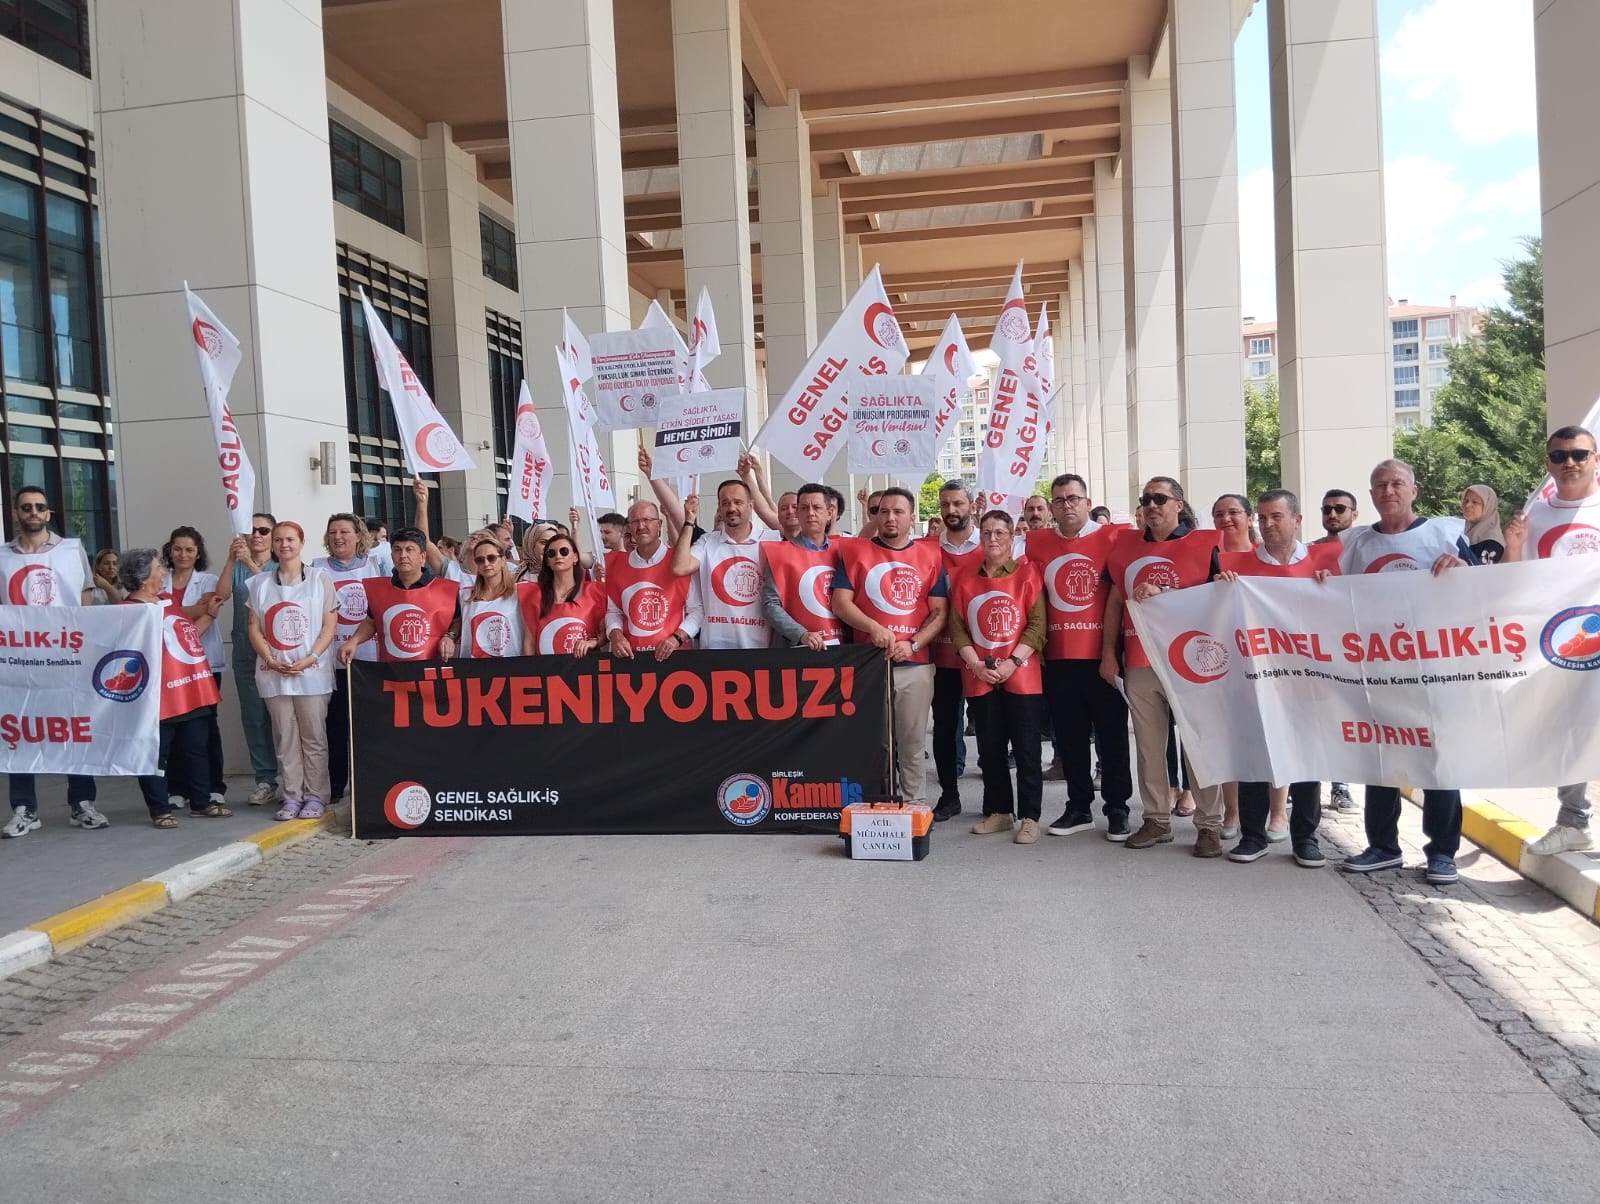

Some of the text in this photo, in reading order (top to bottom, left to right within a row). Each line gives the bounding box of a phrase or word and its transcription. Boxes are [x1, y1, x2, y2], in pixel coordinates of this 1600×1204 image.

[788, 357, 849, 426] GENEL
[860, 394, 922, 407] SAĞLIKTA
[682, 404, 717, 416] SAĞLIKTA
[853, 409, 929, 421] DÖNÜŞÜM PROGRAMINA
[661, 418, 682, 430] ETKİN
[684, 416, 710, 427] ŞİDDET
[856, 420, 927, 434] Son Verilsin!
[663, 424, 732, 444] HEMEN ŞİMDİ!
[707, 616, 729, 624] GENEL
[1234, 627, 1332, 662] GENEL
[1343, 616, 1527, 663] SAĞLIK-İŞ
[8, 657, 45, 668] Çalışanları
[46, 658, 81, 666] Sendikası
[1263, 667, 1289, 678] Sağlık
[1291, 669, 1302, 677] ve
[1367, 676, 1388, 685] Kolu
[1391, 676, 1418, 685] Kamu
[1421, 672, 1474, 685] Çalışanları
[1477, 670, 1527, 681] Sendikası
[383, 660, 855, 728] TÜKENİYORUZ!
[0, 713, 92, 750] ŞUBE
[1341, 719, 1432, 748] EDİRNE
[772, 770, 804, 778] BİRLEŞİK
[435, 788, 559, 805] GENEL SAĞLIK-İŞ
[434, 806, 512, 821] SENDİKASI
[871, 818, 892, 826] ACİL
[857, 829, 907, 838] MÜDAHALE
[862, 842, 900, 851] ÇANTASI
